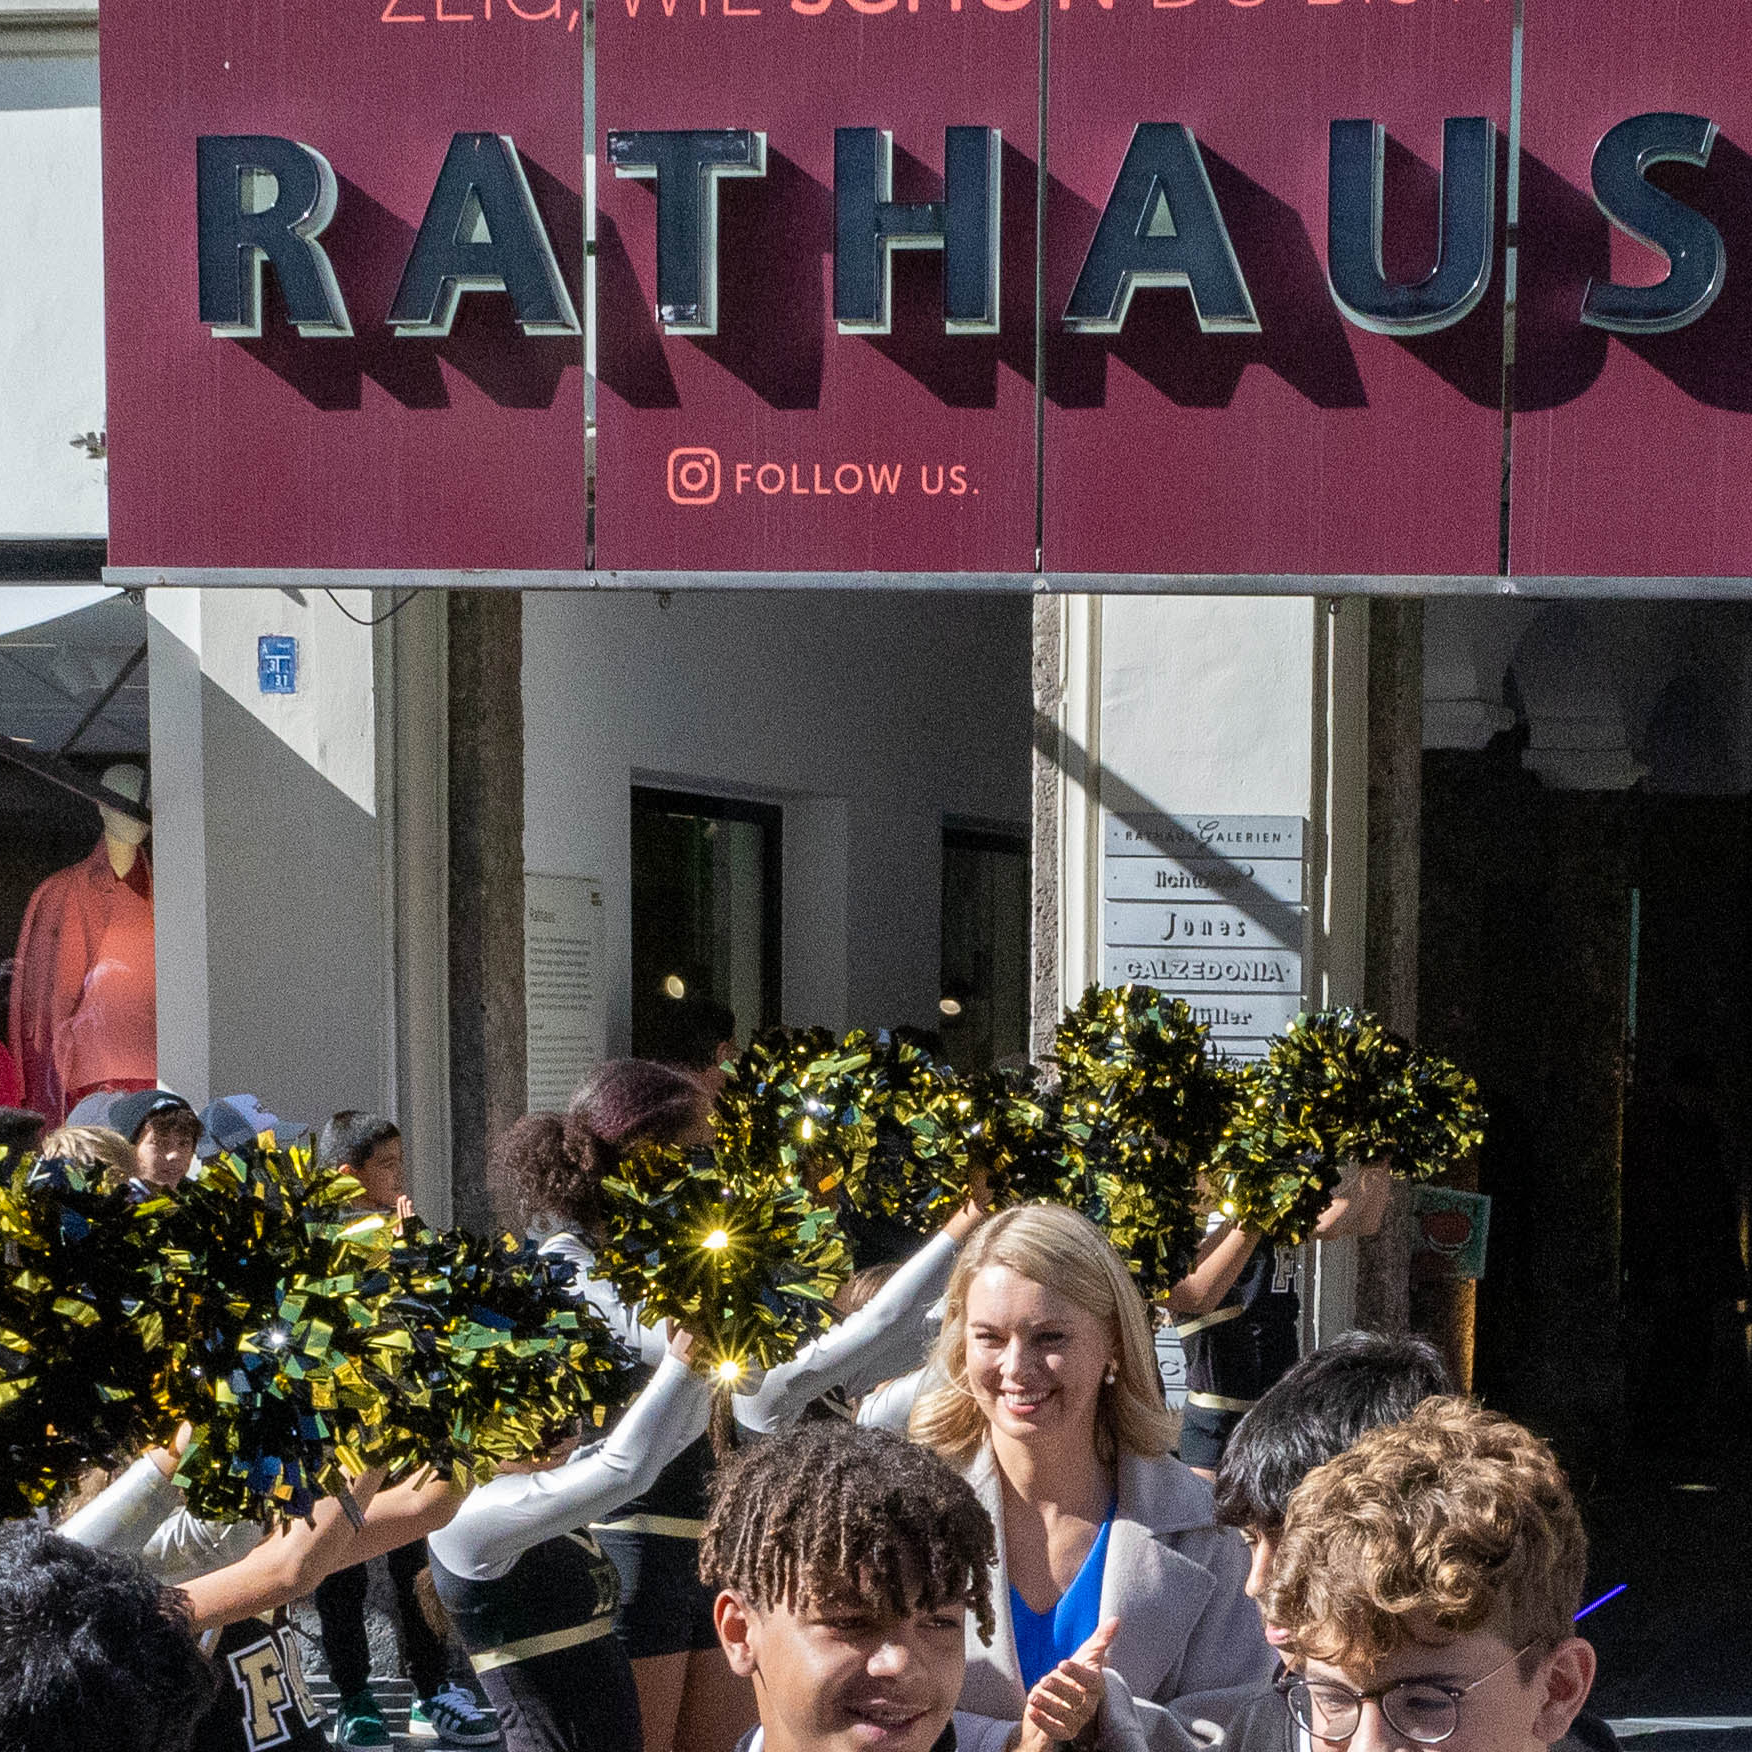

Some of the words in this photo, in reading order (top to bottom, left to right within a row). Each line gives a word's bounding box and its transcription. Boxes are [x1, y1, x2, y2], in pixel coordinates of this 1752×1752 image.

[196, 113, 1724, 338] RATHAUS
[735, 463, 902, 495] FOLLOW
[921, 464, 979, 495] US.
[1160, 912, 1247, 941] Jones
[1125, 958, 1285, 983] CALZEDONIA
